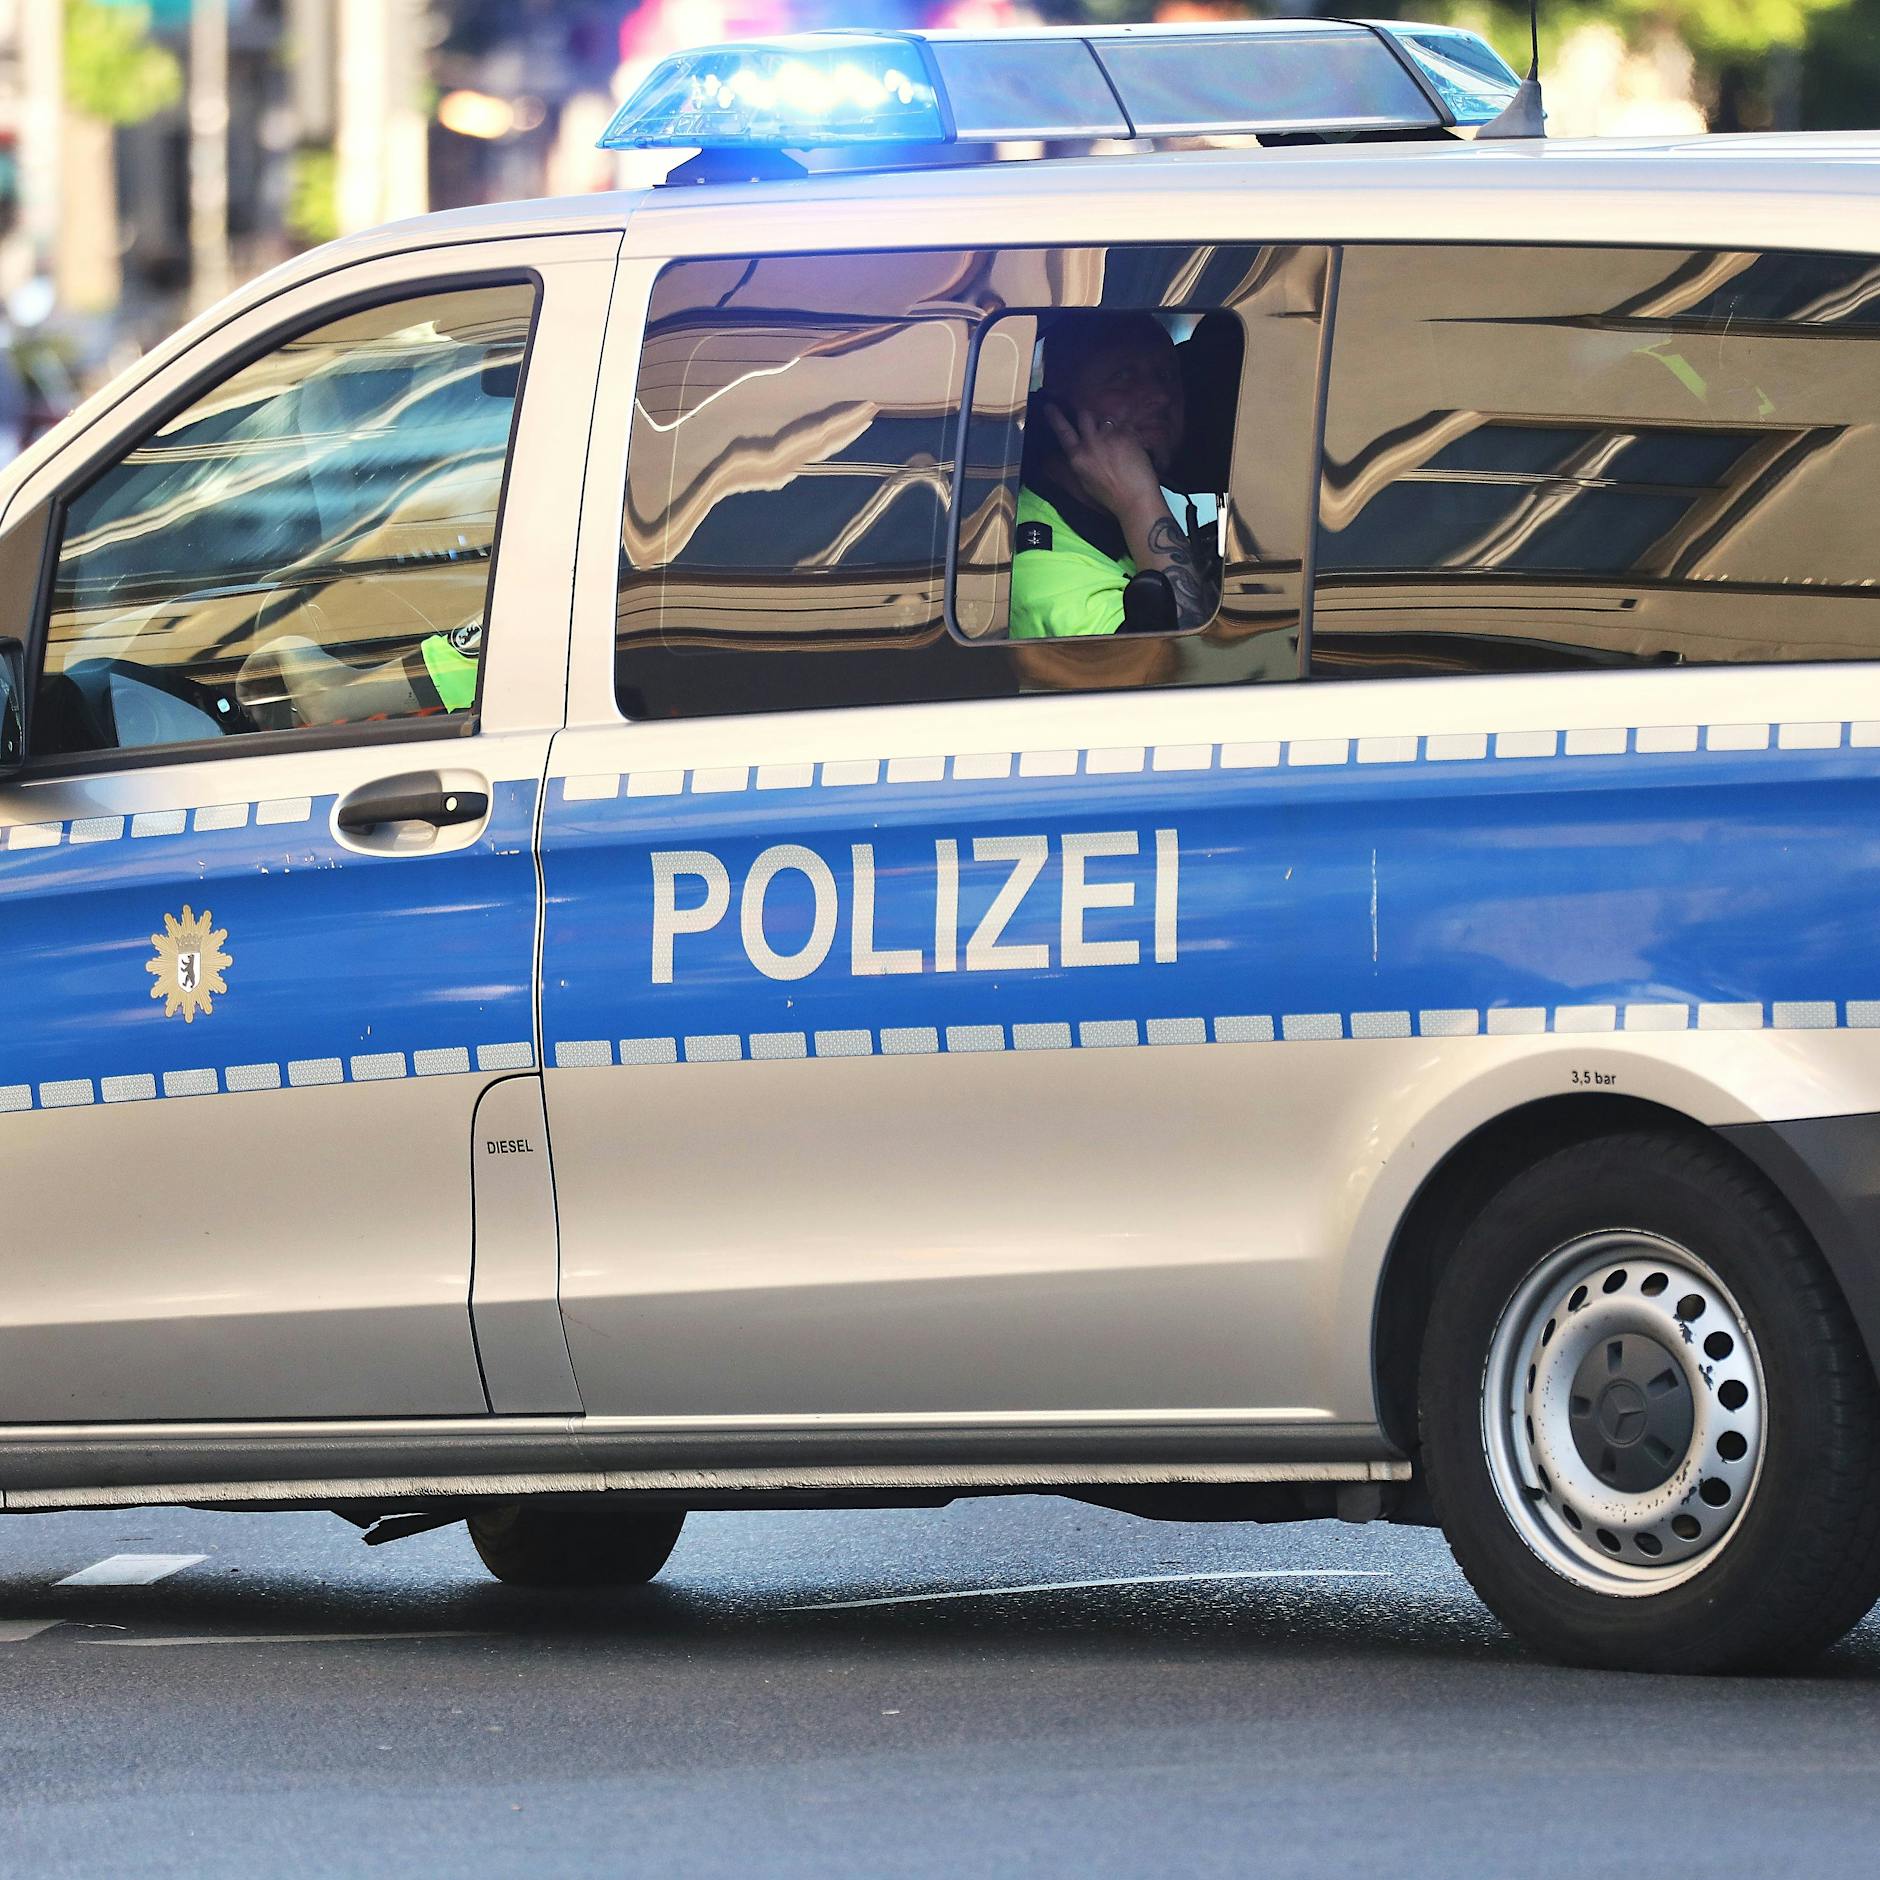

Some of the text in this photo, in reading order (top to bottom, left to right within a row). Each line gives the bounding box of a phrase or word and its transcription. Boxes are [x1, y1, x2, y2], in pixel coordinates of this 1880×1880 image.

[650, 828, 1179, 984] POLIZEI
[1572, 1070, 1616, 1086] 3,5 bar
[487, 1139, 534, 1154] DIESEL
